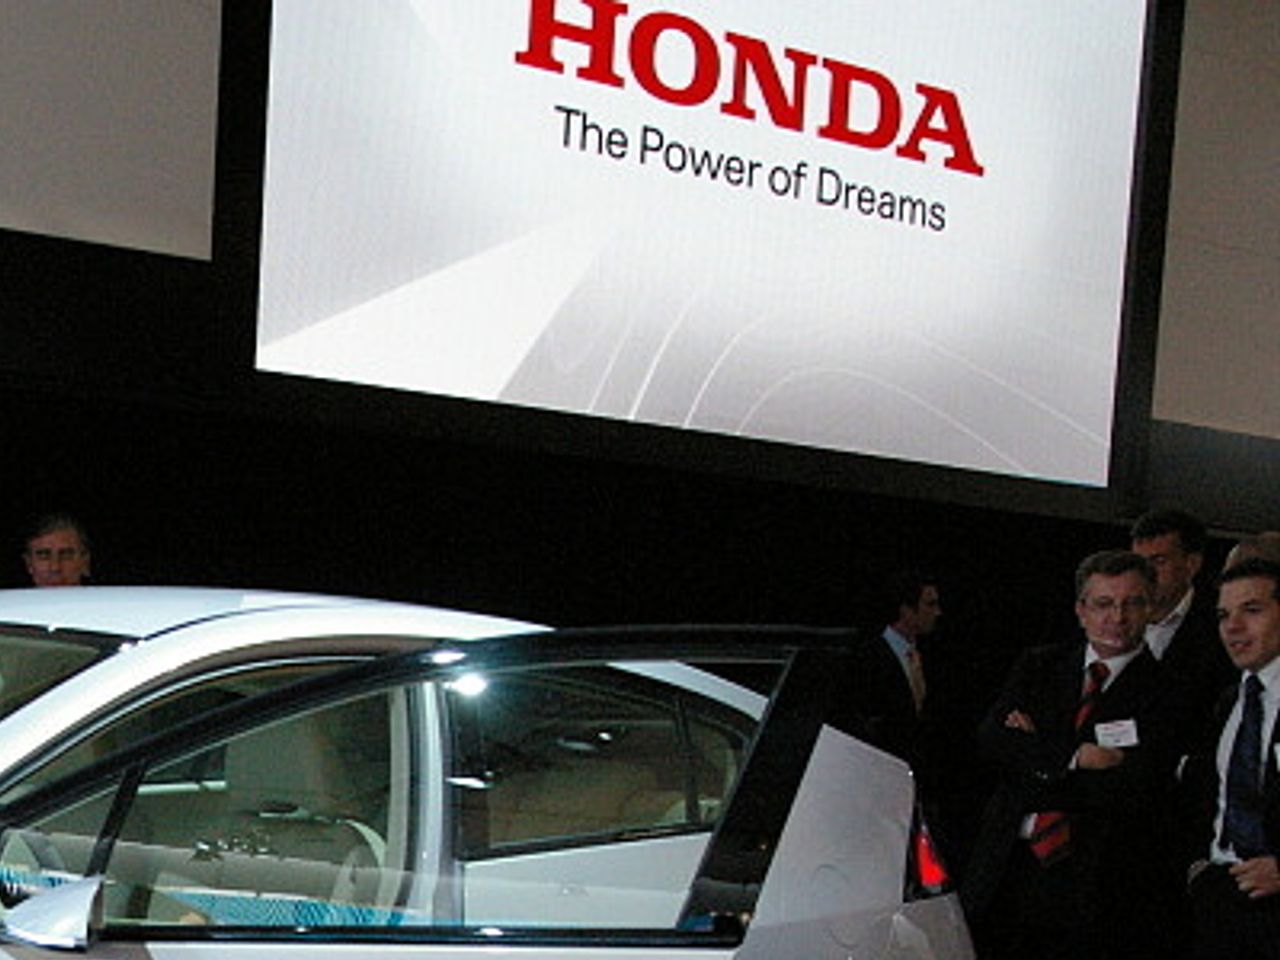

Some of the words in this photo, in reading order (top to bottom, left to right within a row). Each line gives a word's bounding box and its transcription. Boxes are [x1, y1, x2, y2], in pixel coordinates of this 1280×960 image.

[515, 0, 984, 177] HONDA
[554, 105, 629, 160] The
[639, 125, 764, 188] Power
[767, 161, 809, 198] of
[816, 166, 947, 232] Dreams
